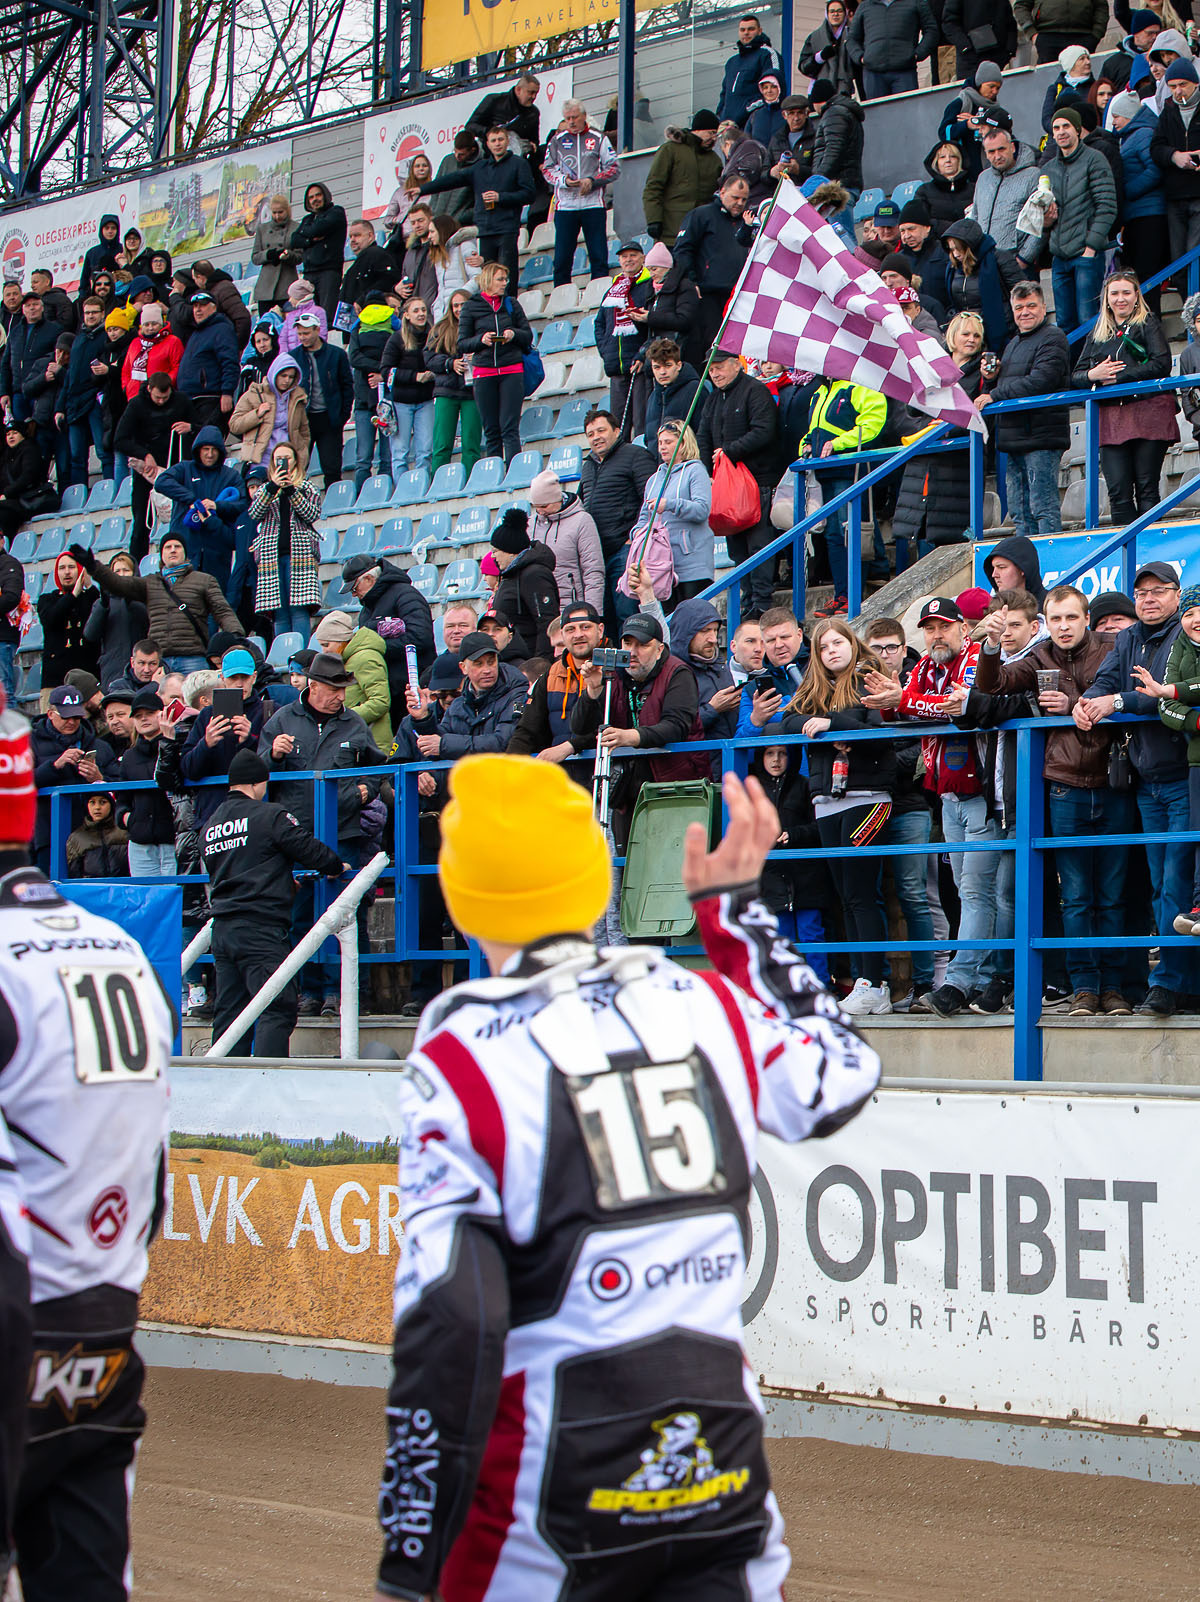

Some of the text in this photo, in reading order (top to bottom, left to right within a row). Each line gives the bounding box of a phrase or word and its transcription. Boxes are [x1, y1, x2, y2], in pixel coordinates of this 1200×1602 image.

[512, 6, 575, 33] TRAVEL
[34, 219, 97, 248] OLEGSEXPRESS
[1074, 426, 1080, 435] 1
[522, 454, 532, 463] 11
[63, 695, 80, 705] AJ
[205, 817, 249, 842] GROM
[204, 836, 249, 856] SECURITY
[74, 973, 149, 1073] 10
[575, 1062, 717, 1202] 15
[287, 1178, 404, 1256] AGR
[805, 1164, 1158, 1304] OPTIBET
[645, 1253, 738, 1290] OPTIBET
[806, 1295, 1161, 1351] SPORTA BĀRS
